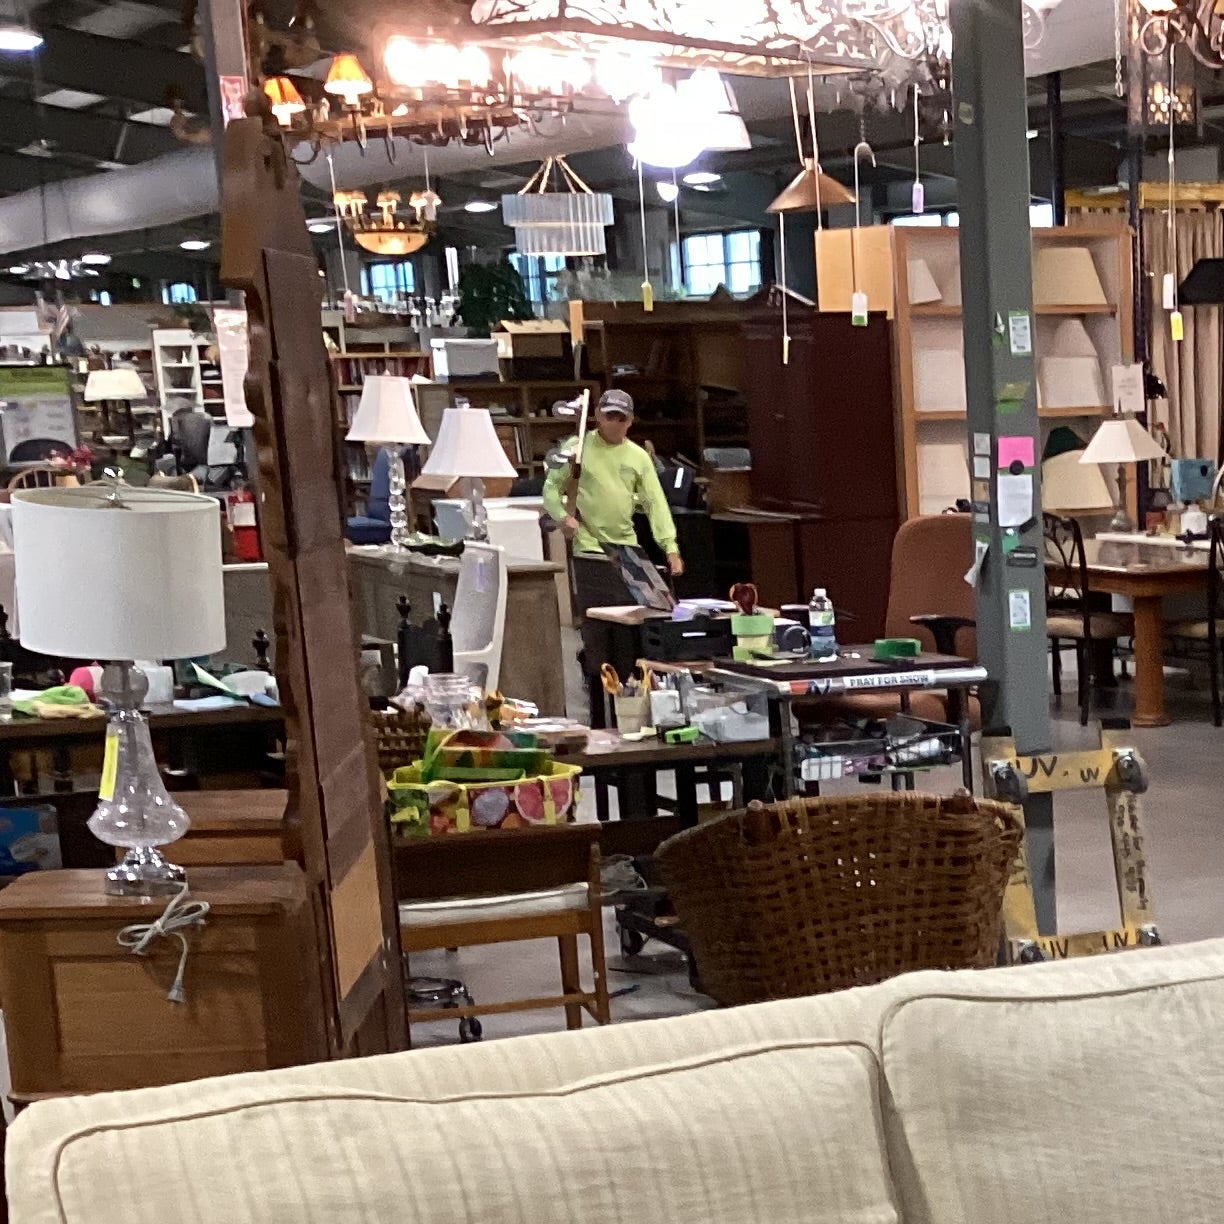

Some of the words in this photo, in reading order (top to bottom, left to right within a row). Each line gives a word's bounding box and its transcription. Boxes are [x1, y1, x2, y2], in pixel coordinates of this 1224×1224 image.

[850, 678, 875, 688] PRAY
[877, 675, 898, 685] FOR
[899, 673, 929, 684] SNOW
